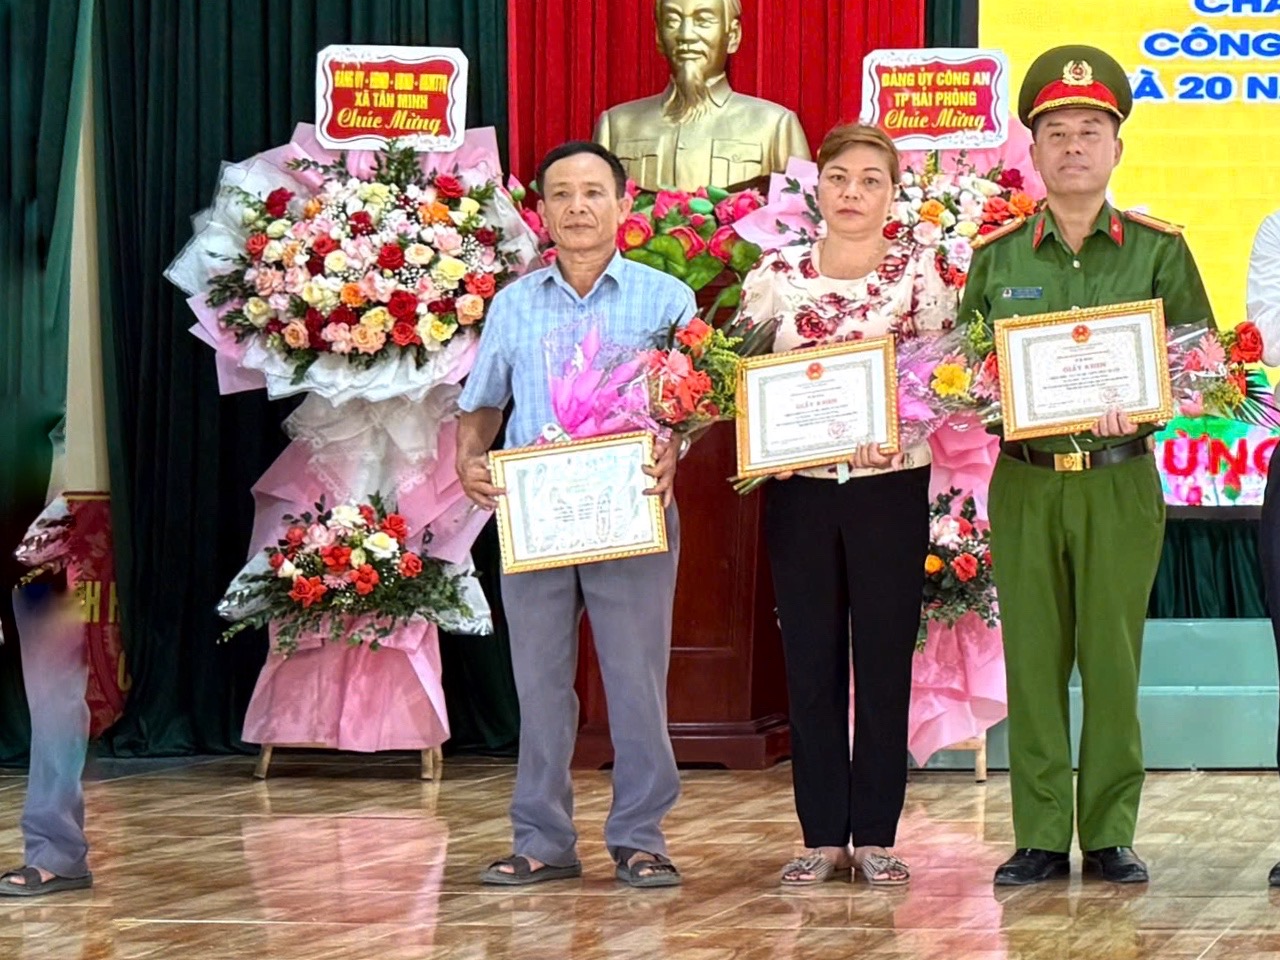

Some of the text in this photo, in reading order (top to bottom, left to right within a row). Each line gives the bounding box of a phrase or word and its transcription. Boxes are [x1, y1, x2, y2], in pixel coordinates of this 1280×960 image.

[881, 67, 915, 87] ĐẢNG
[936, 70, 970, 86] CÔNG
[973, 72, 991, 86] AN
[1131, 70, 1163, 100] À
[1179, 77, 1232, 100] 20
[354, 90, 428, 109] XÃ TÂN MINH
[895, 86, 977, 107] TP HẢI PHÒNG
[337, 108, 442, 135] Chúc Mừng
[884, 108, 986, 133] Chúc Mừng
